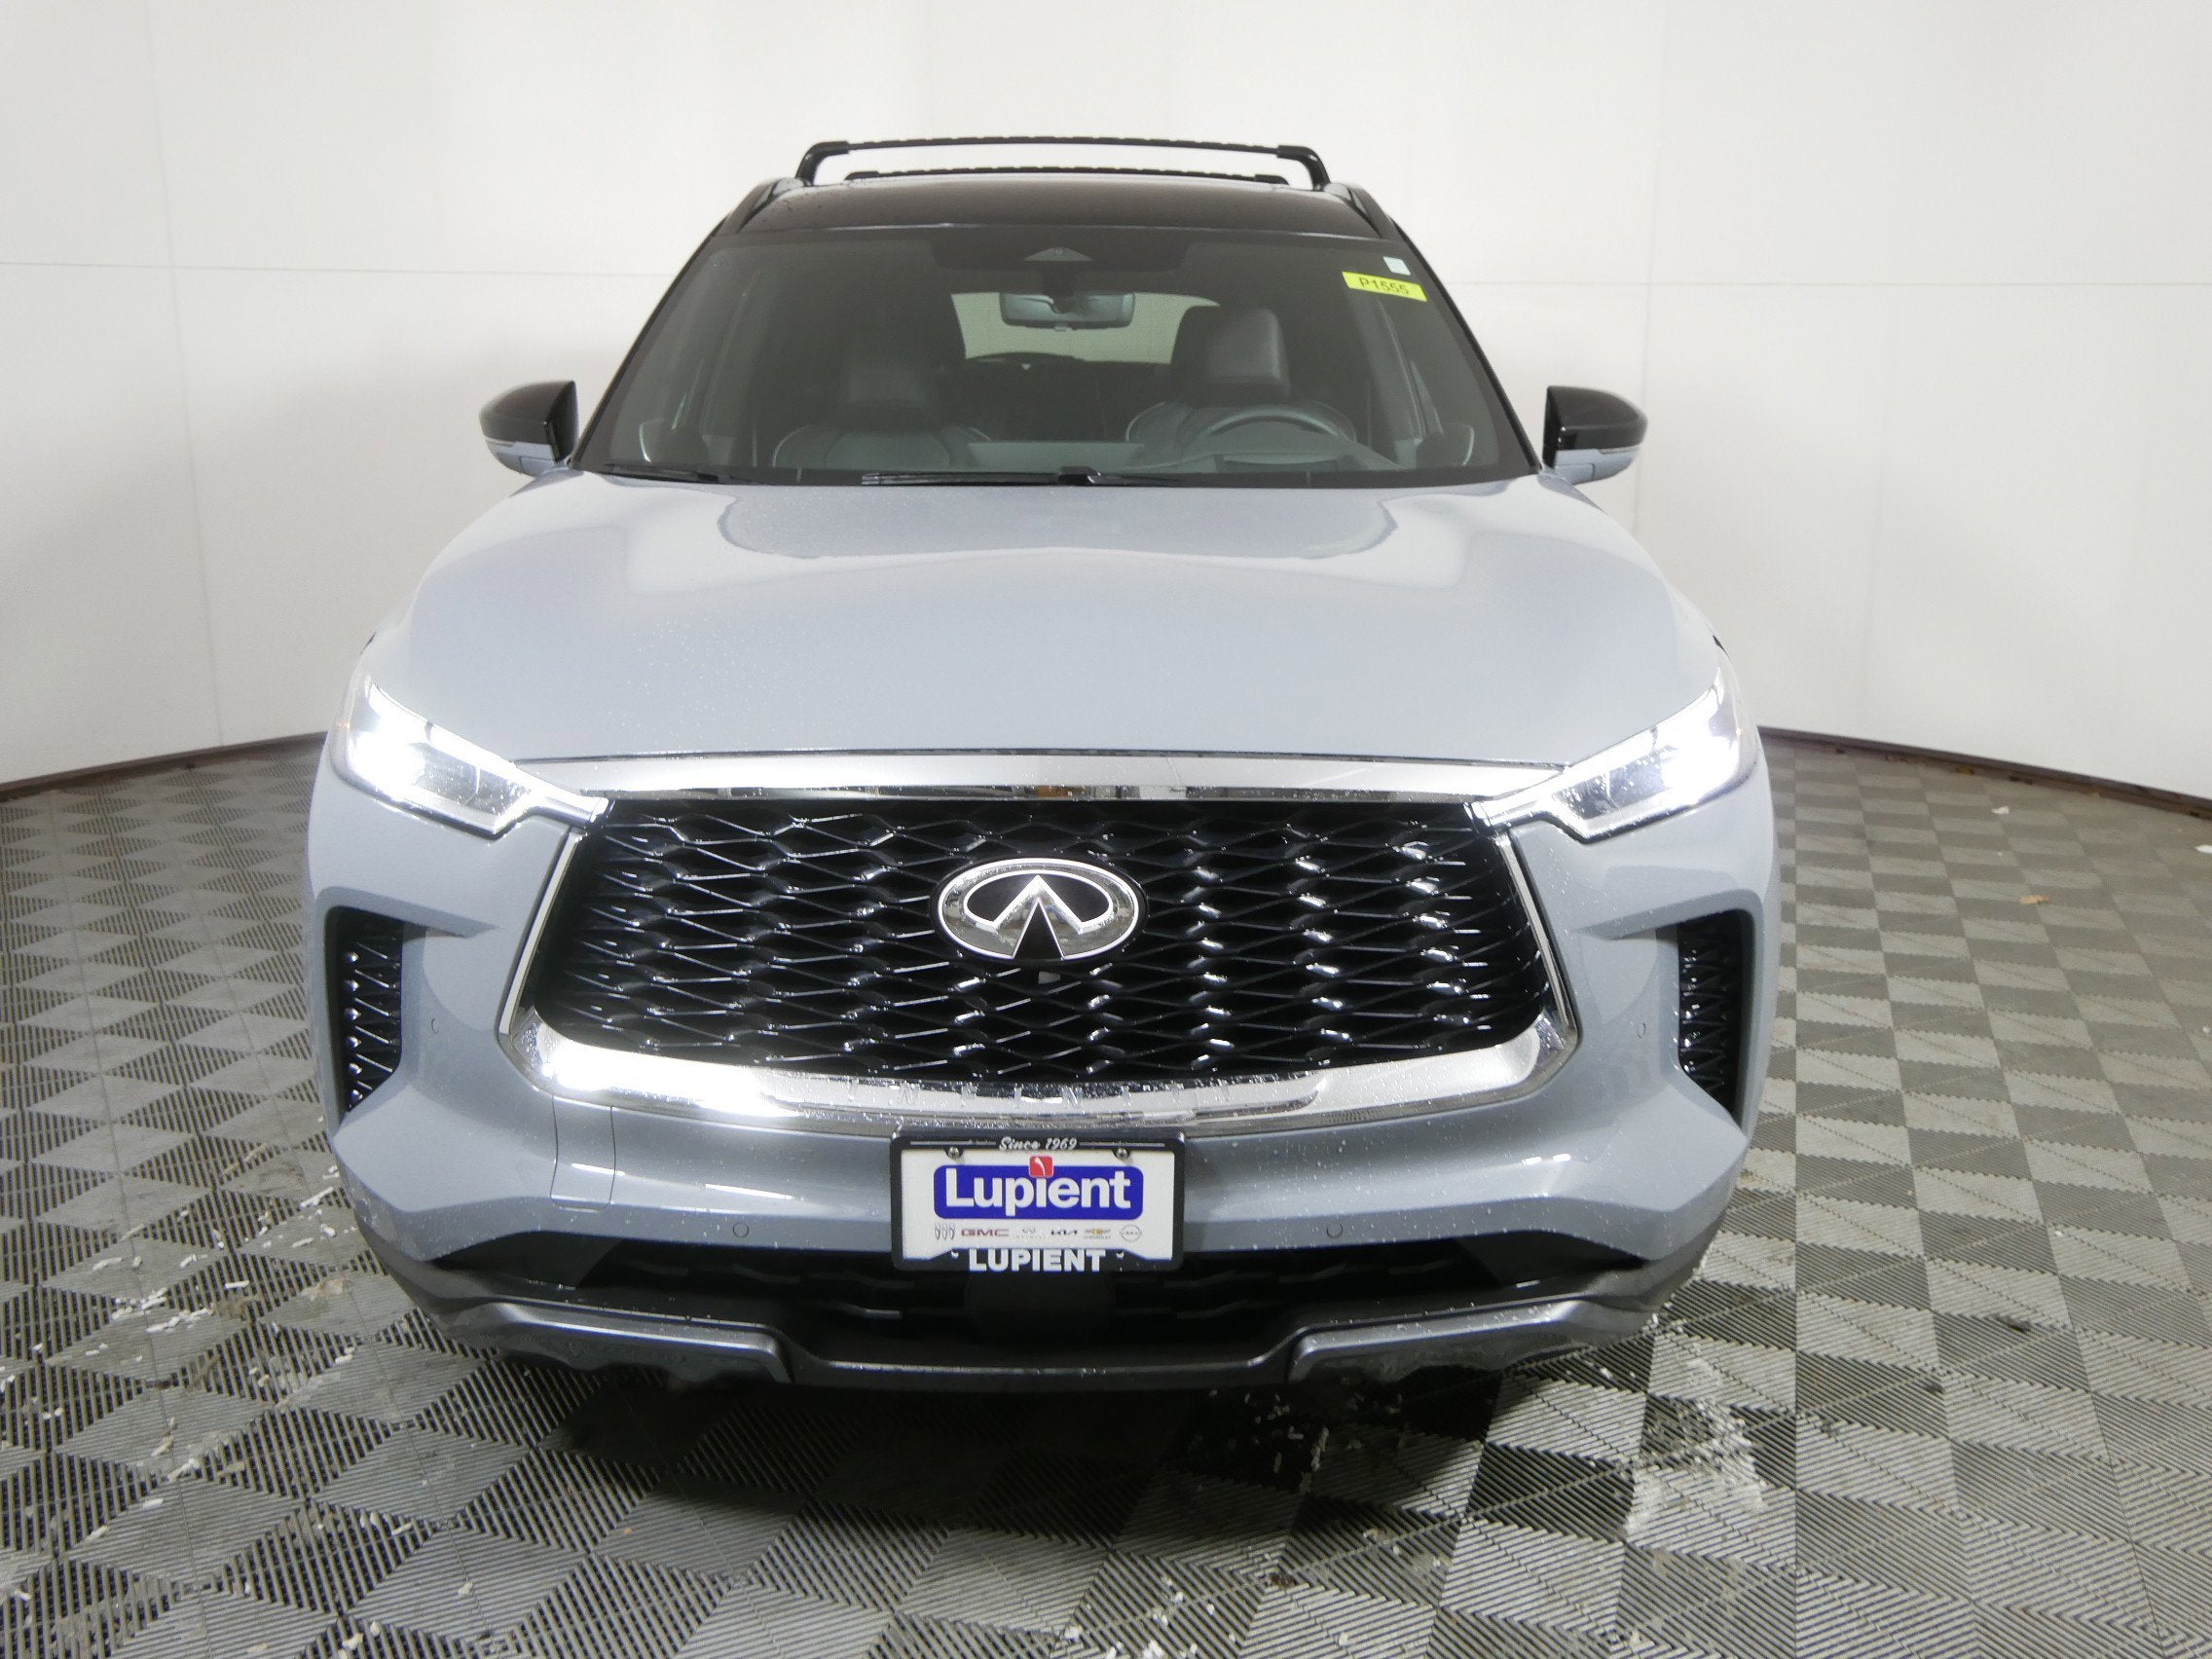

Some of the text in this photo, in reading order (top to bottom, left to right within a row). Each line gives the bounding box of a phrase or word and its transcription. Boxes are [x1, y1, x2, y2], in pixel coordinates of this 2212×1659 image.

[1358, 277, 1409, 295] P1555
[998, 1136, 1078, 1151] Since 1969
[945, 1167, 1131, 1217] Lupient
[961, 1228, 1010, 1236] GMC
[969, 1249, 1106, 1272] LUPIENT
